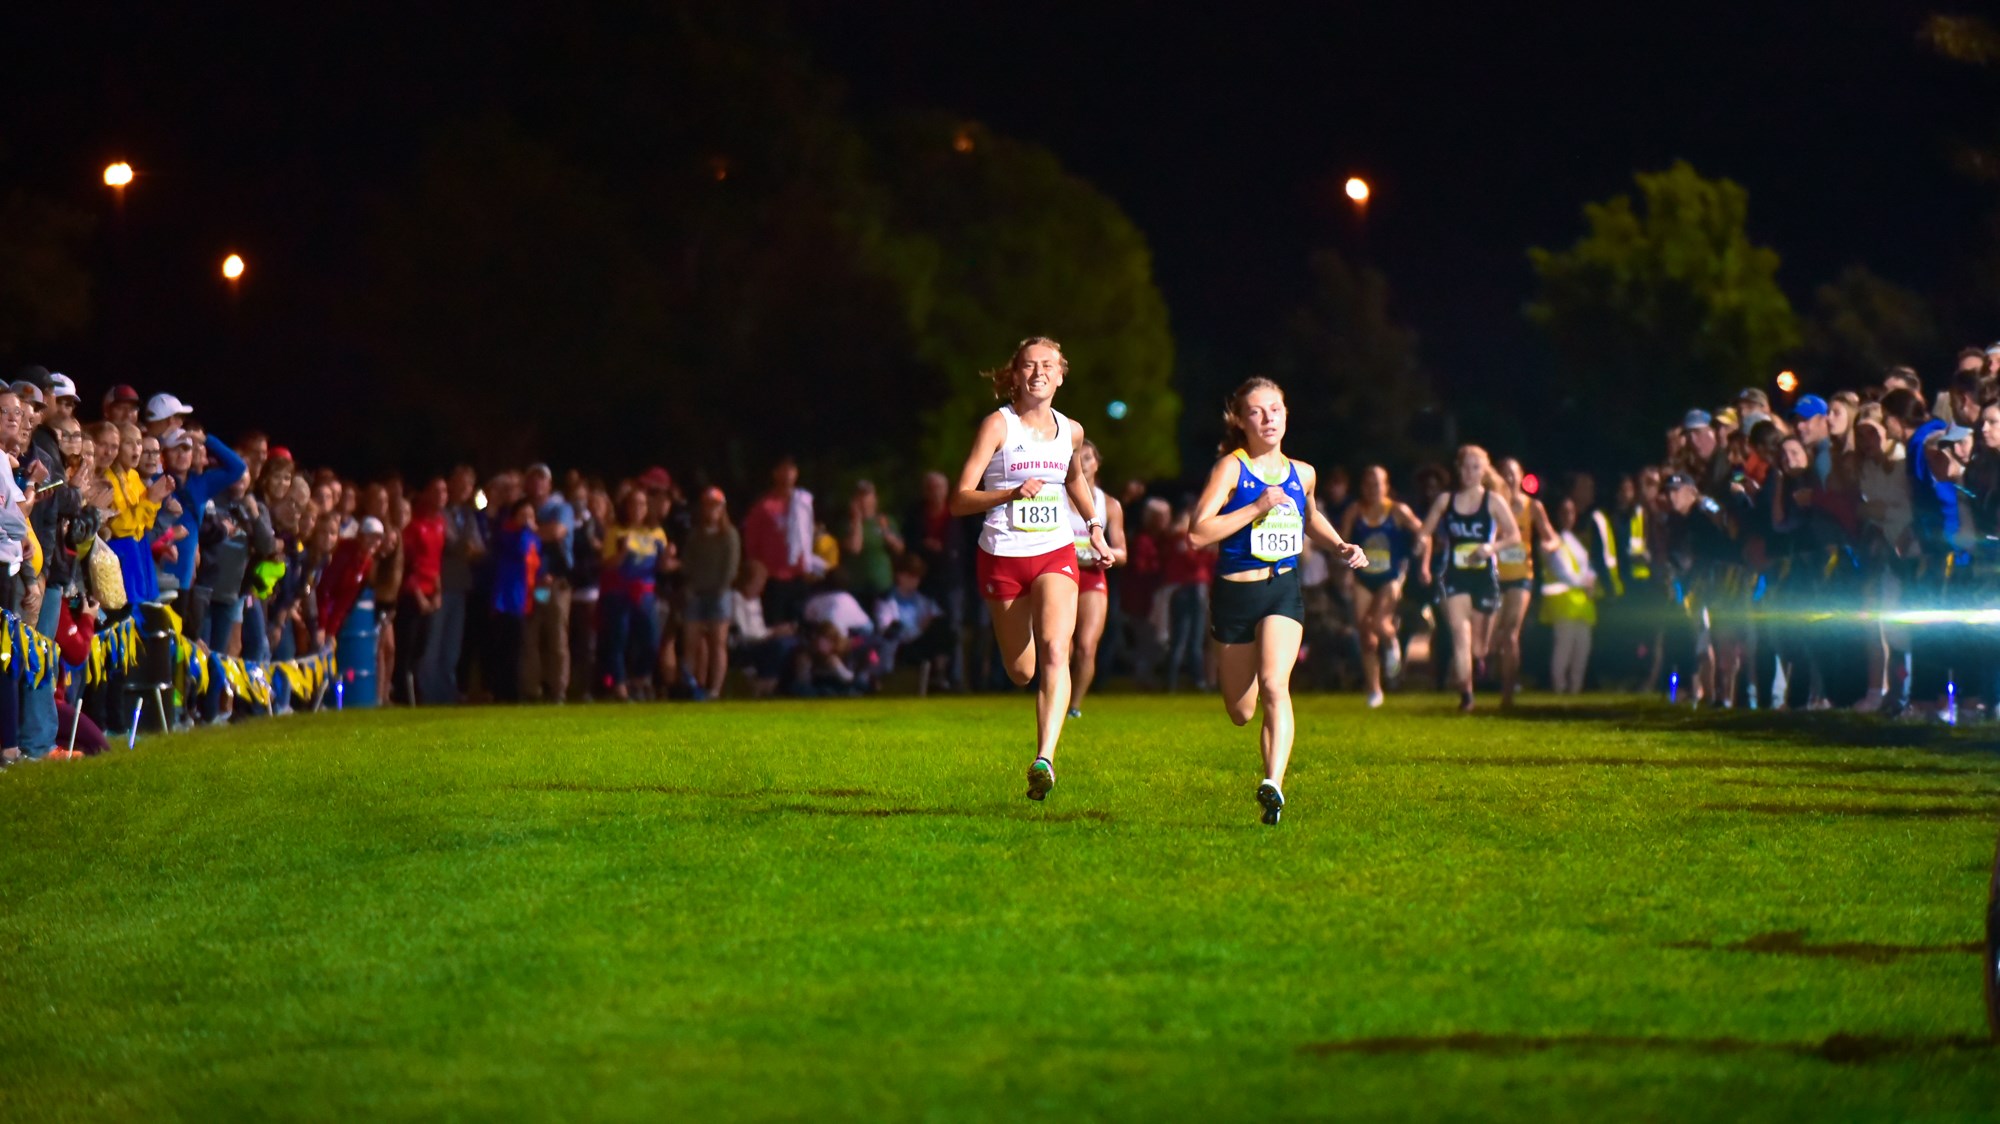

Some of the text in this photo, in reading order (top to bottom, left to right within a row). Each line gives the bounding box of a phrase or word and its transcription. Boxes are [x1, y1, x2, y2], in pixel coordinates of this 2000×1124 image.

[1010, 461, 1040, 471] SOUTH
[1018, 506, 1057, 523] 1831
[1257, 533, 1296, 551] 1851
